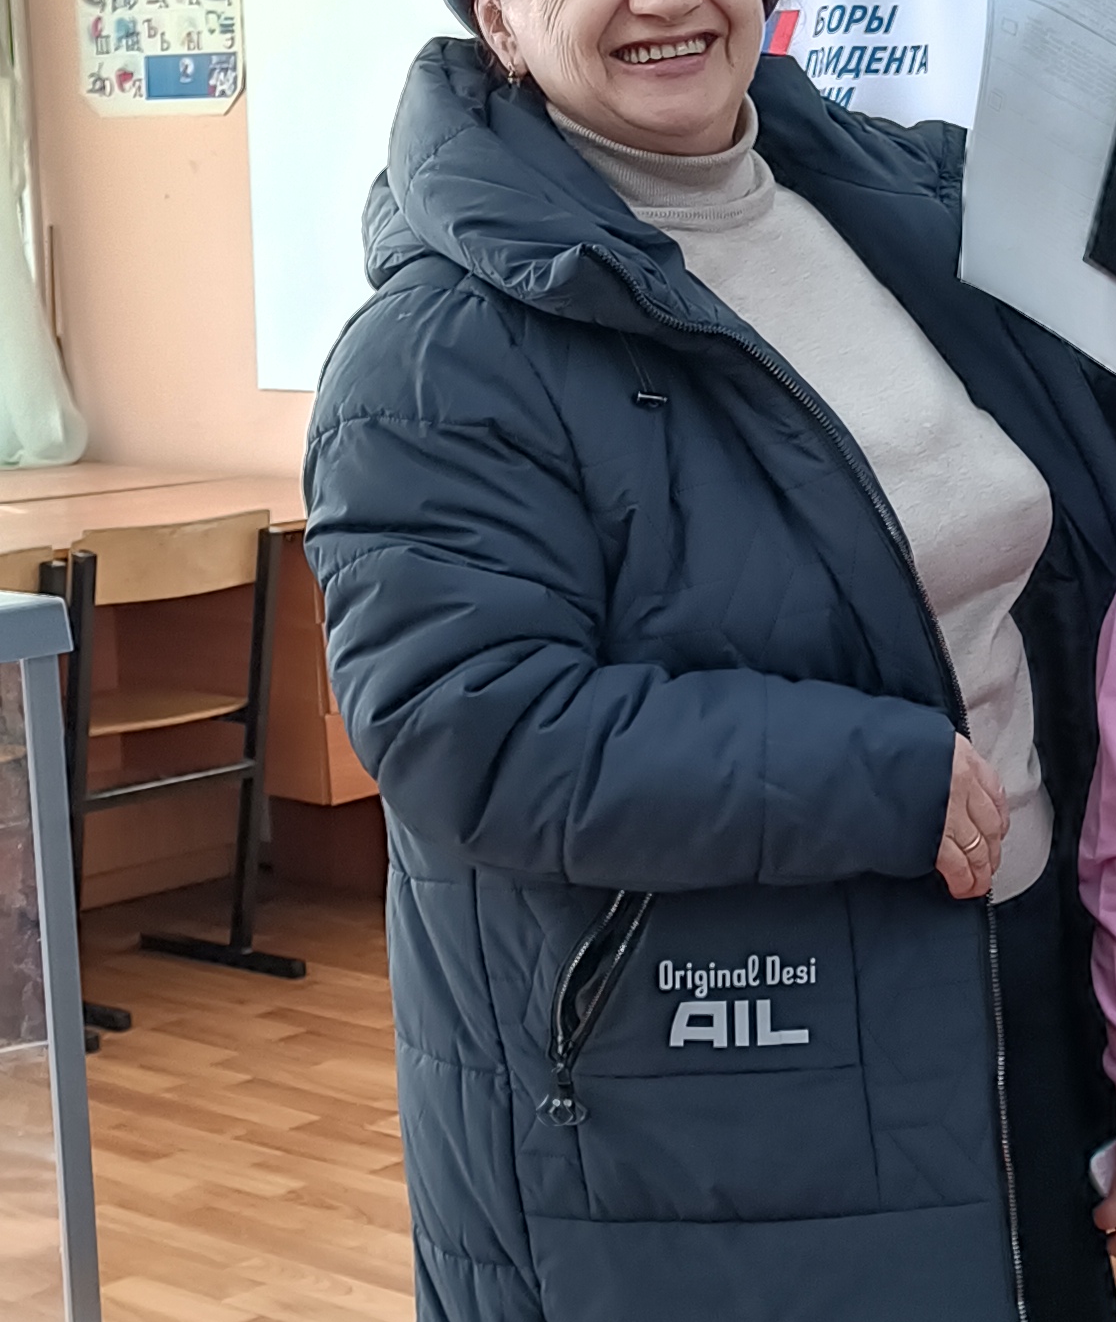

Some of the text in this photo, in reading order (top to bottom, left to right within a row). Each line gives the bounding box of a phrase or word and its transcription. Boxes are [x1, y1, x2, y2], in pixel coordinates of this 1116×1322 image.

[659, 954, 817, 998] Original Desi
[669, 999, 809, 1048] AIL
